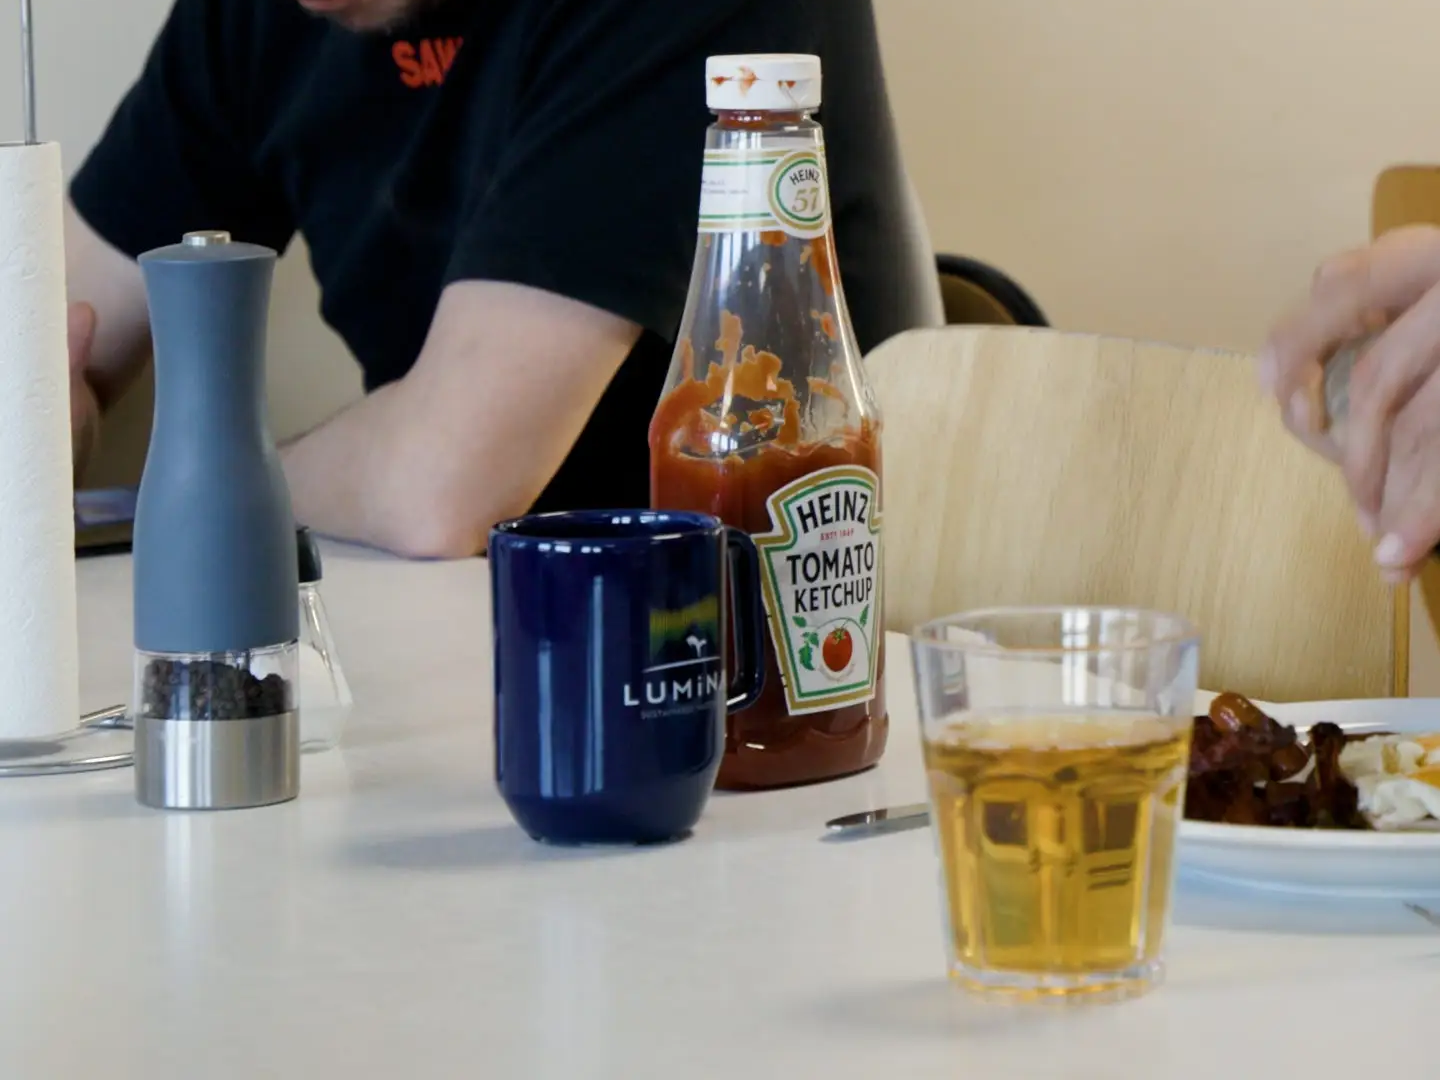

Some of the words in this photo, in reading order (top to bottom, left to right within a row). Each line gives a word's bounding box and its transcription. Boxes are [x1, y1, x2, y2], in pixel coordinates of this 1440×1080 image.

[392, 36, 464, 88] SAV
[790, 168, 820, 186] HEINZ
[791, 187, 819, 212] 57
[797, 491, 869, 534] HEINZ
[786, 540, 874, 585] TOMATO
[794, 576, 873, 614] KETCHUP
